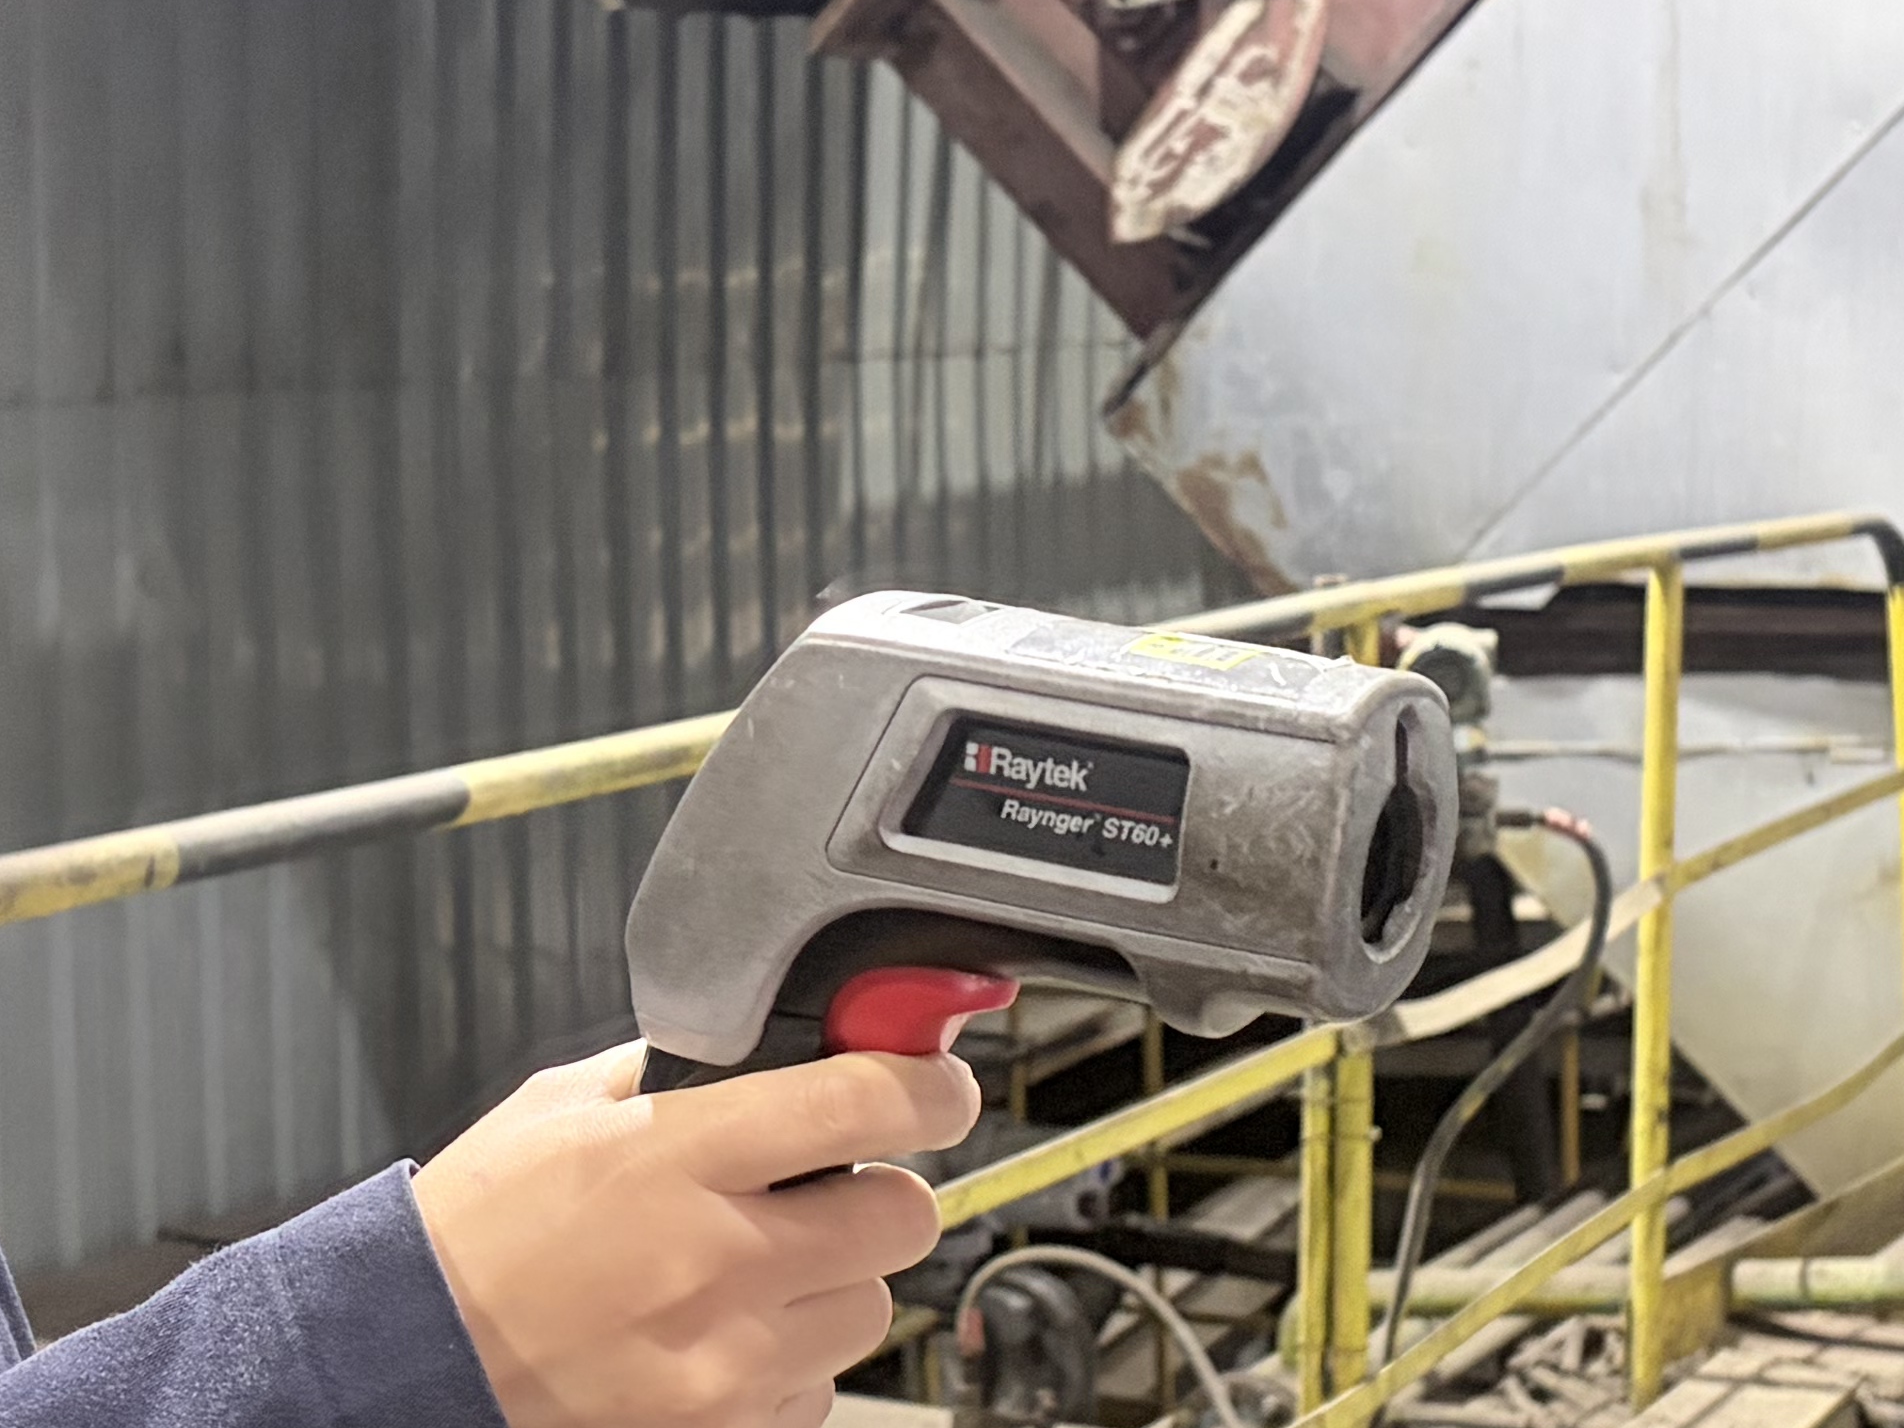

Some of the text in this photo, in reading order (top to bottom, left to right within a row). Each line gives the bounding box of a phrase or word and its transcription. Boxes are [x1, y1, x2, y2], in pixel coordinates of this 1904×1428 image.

[989, 746, 1088, 792] Raytek
[1000, 798, 1174, 849] Raynger ST60+
